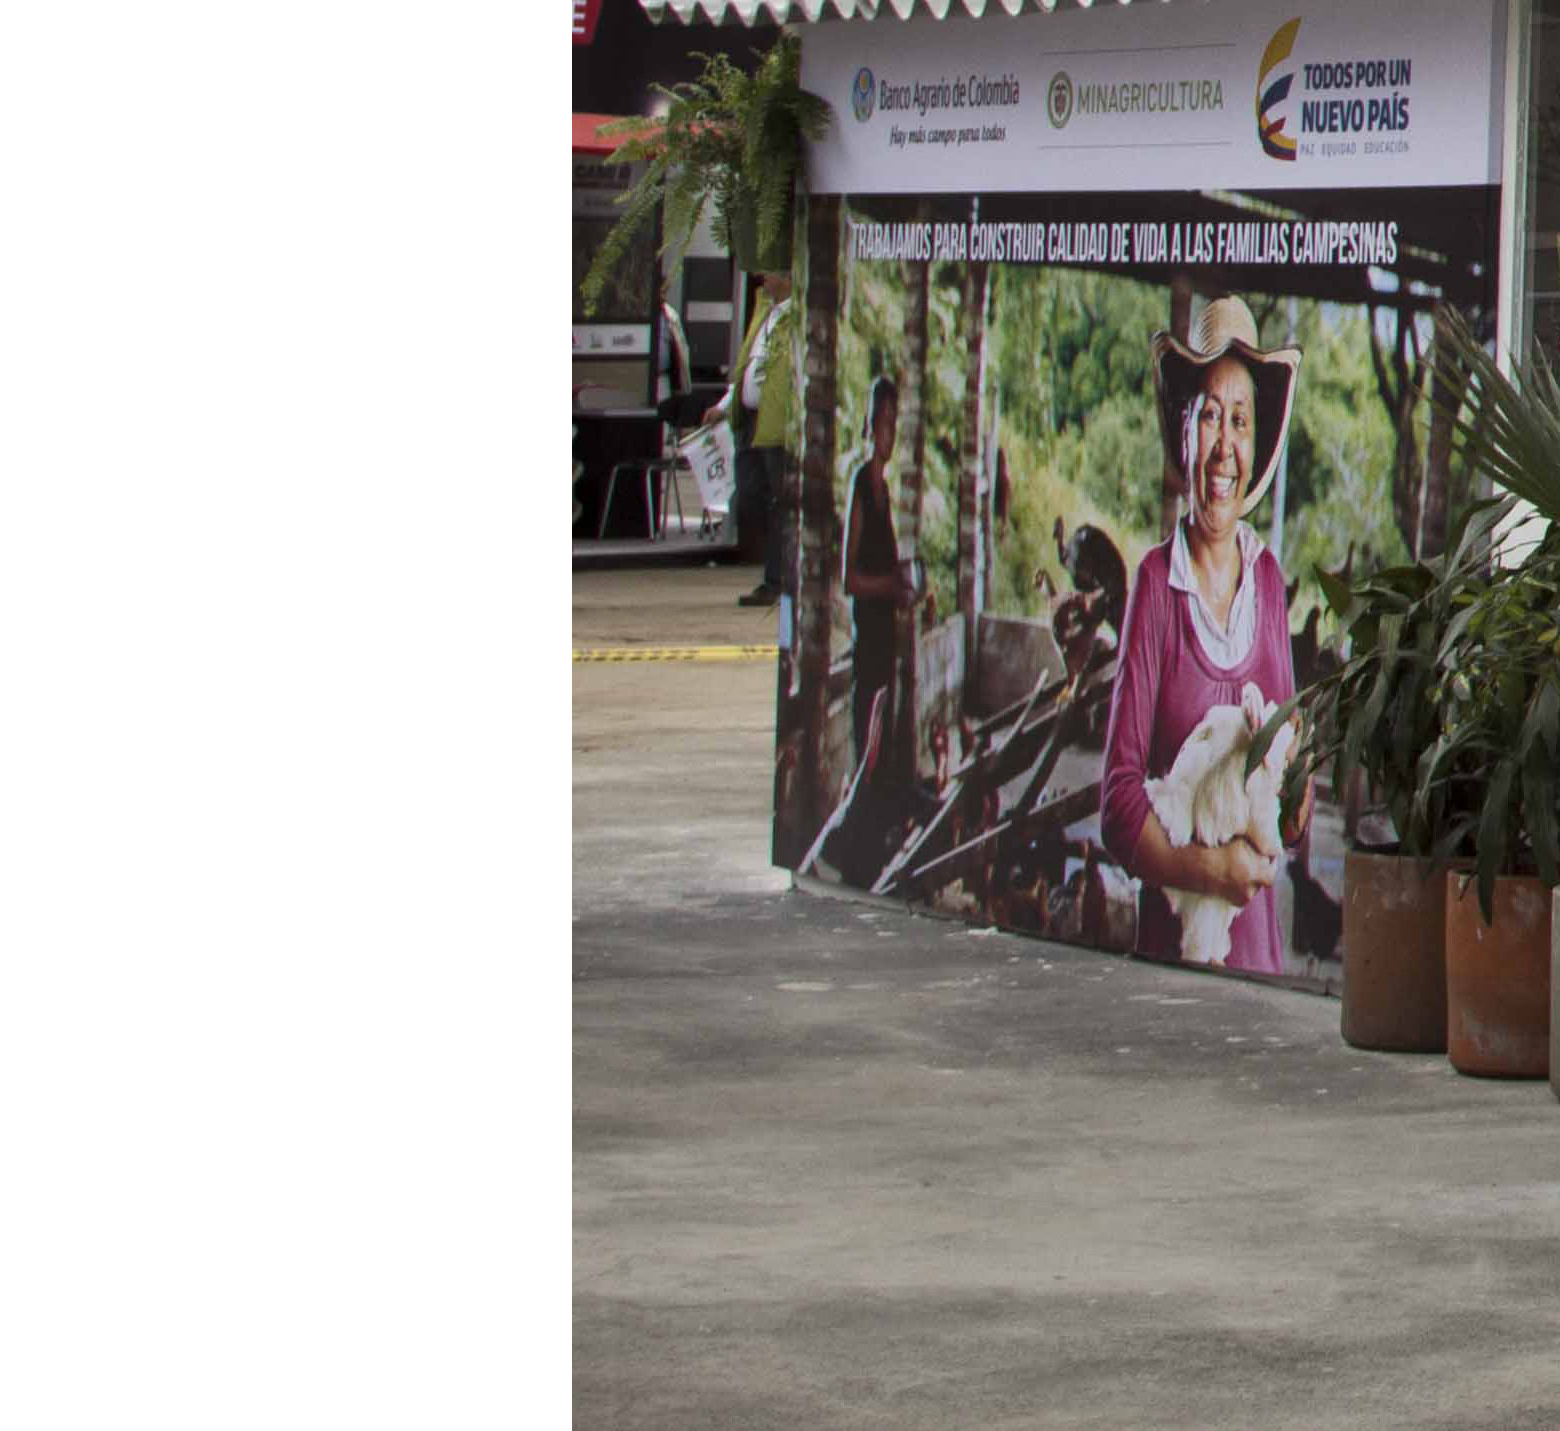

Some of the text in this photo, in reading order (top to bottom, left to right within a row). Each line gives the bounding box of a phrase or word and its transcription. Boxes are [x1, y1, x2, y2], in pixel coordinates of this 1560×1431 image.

[879, 73, 1020, 116] Banco Agrario de Colombia
[1303, 58, 1412, 90] TODOS POR UN
[1077, 79, 1224, 114] MINAGRICULTURA
[1302, 91, 1410, 134] NUEVO PAÍS
[850, 221, 1398, 265] TRABAJAMOS PARA CONSTRUIR CALIDAD DE VIDA A LAS FAMILIAS CAMPESINAS
